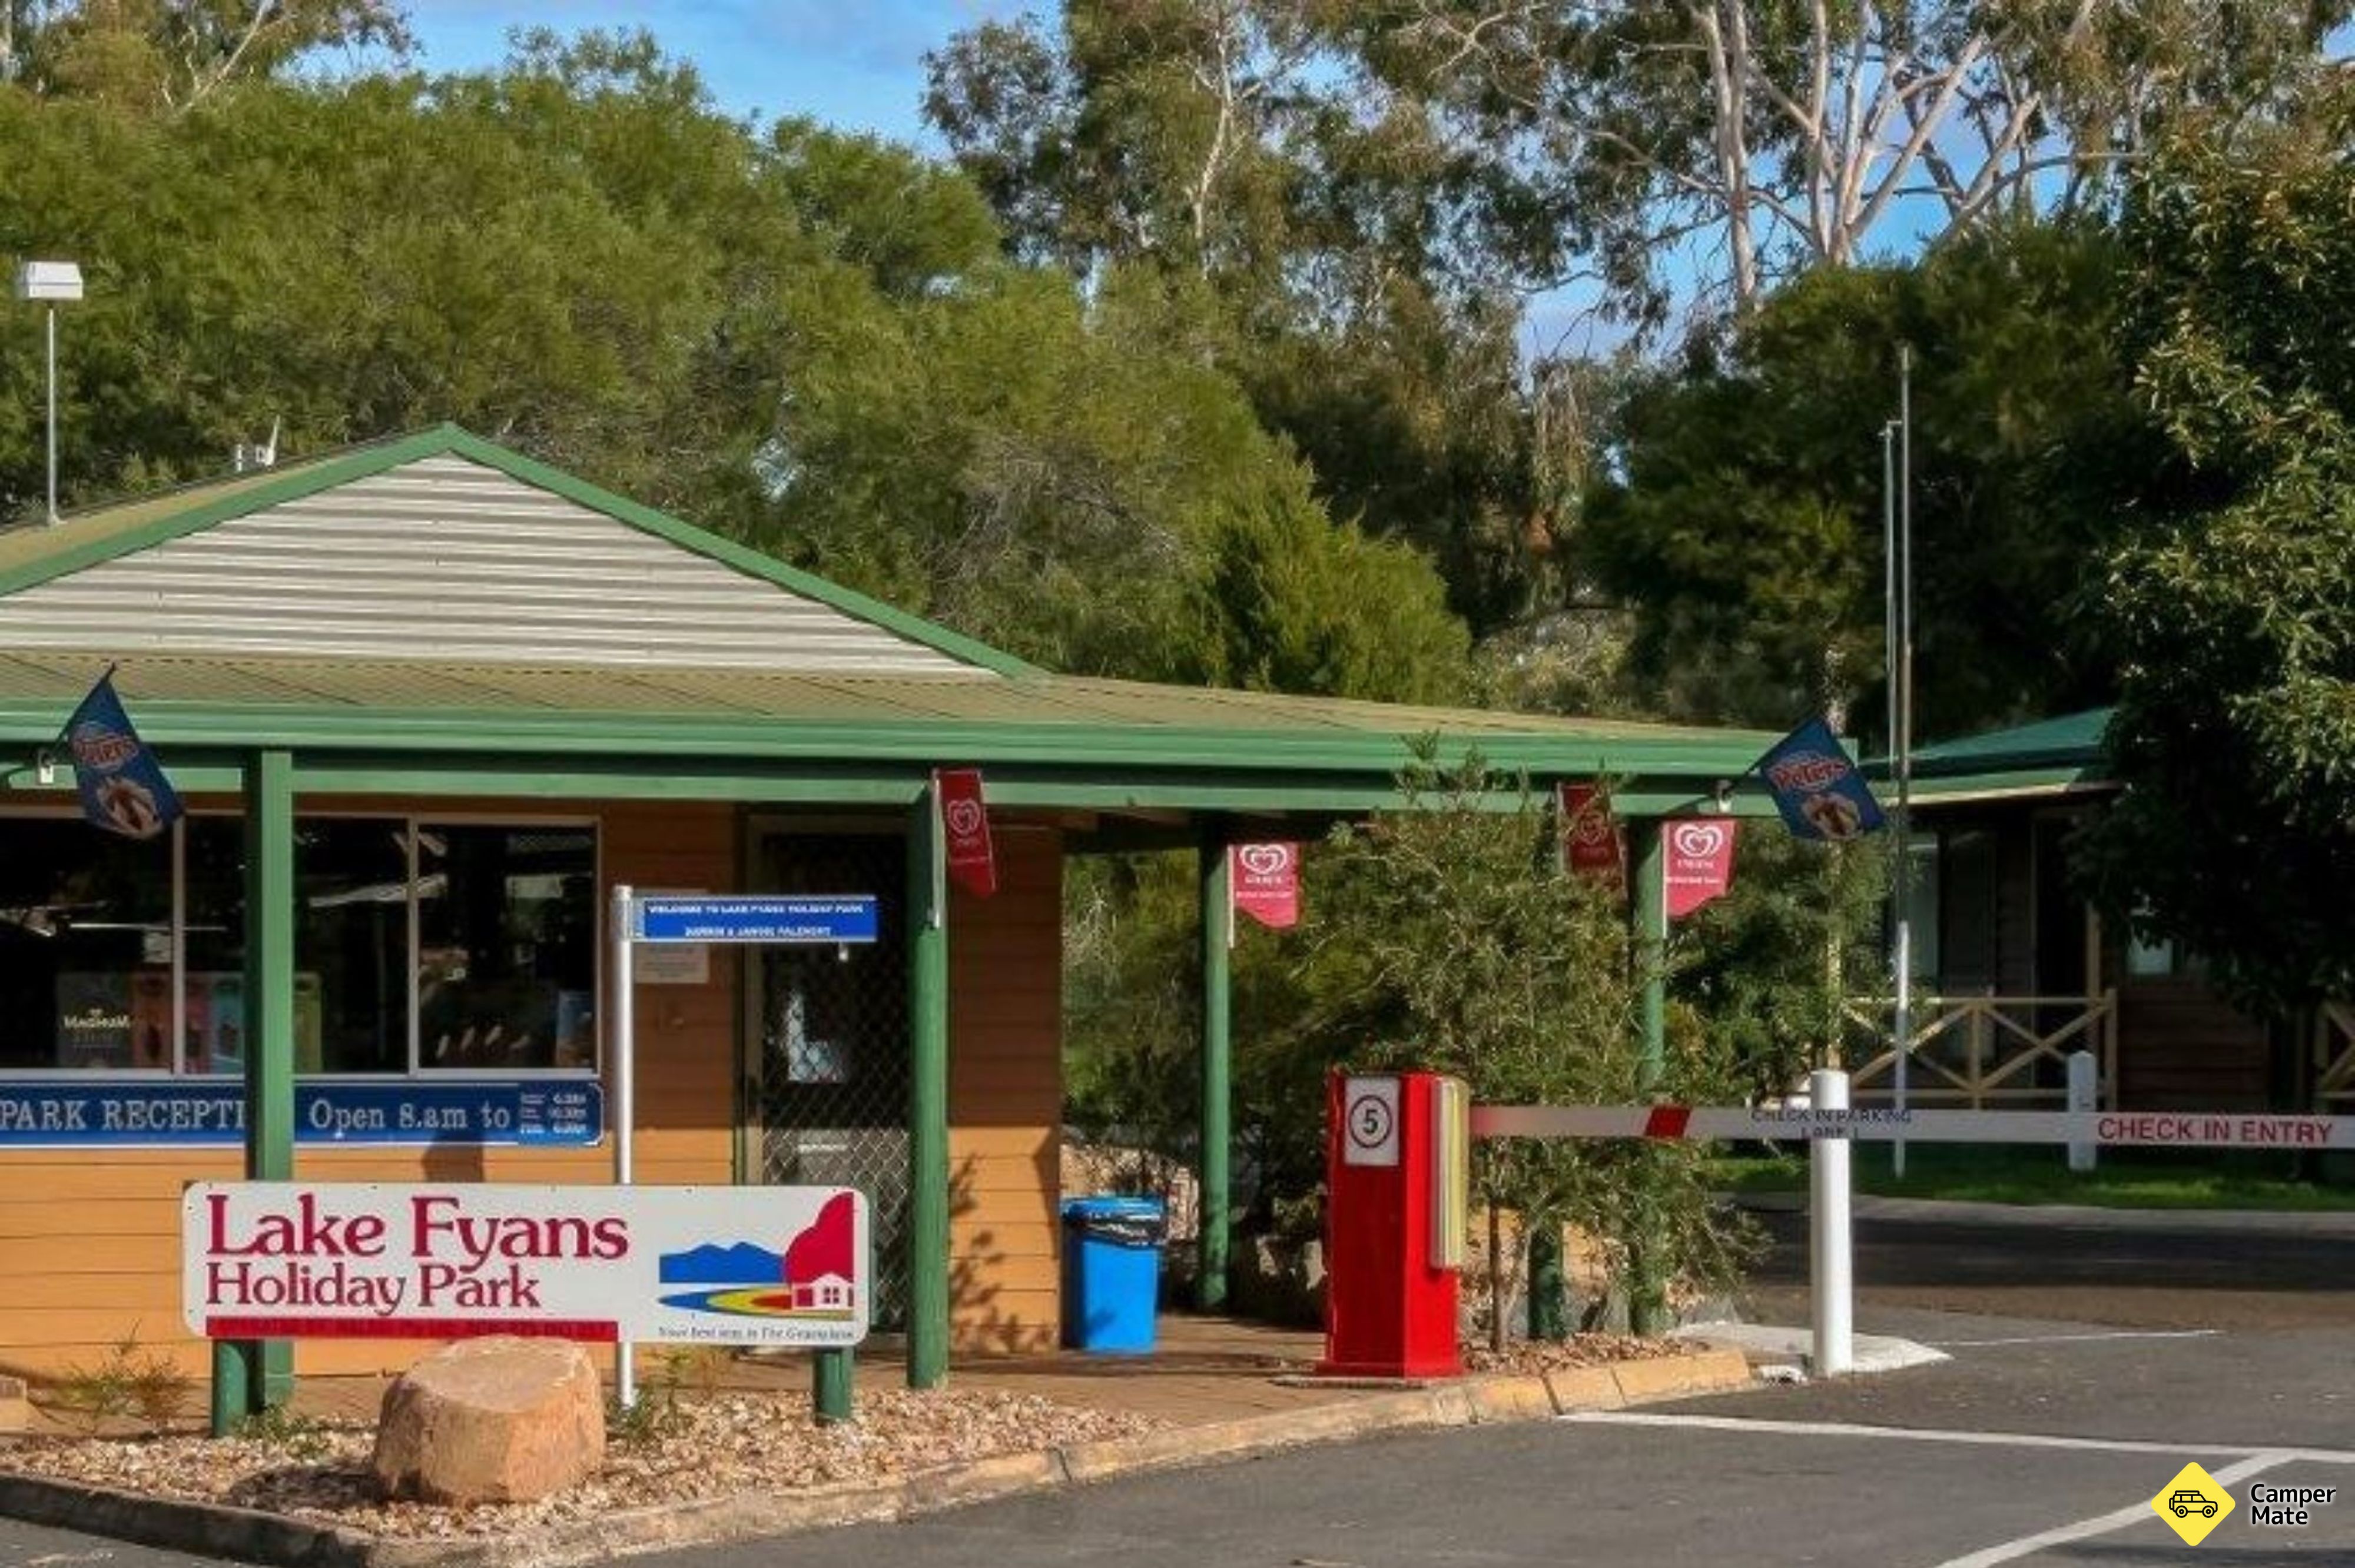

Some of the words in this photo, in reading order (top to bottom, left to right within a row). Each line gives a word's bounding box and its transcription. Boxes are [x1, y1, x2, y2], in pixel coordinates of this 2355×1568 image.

[0, 1100, 87, 1131] PARK
[101, 1100, 244, 1131] RECEPTI
[310, 1098, 386, 1138] Open
[480, 1101, 510, 1128] to
[1362, 1108, 1378, 1135] 5
[1751, 1109, 1810, 1122] CHECK
[1816, 1109, 1831, 1122] IN
[1835, 1109, 1912, 1122] PARKING
[2098, 1117, 2194, 1140] CHECK
[2204, 1120, 2230, 1141] IN
[2241, 1120, 2334, 1144] ENTRY
[206, 1194, 386, 1257] Lake
[410, 1196, 629, 1273] Fyans
[206, 1262, 406, 1316] Holiday
[417, 1264, 540, 1308] Park
